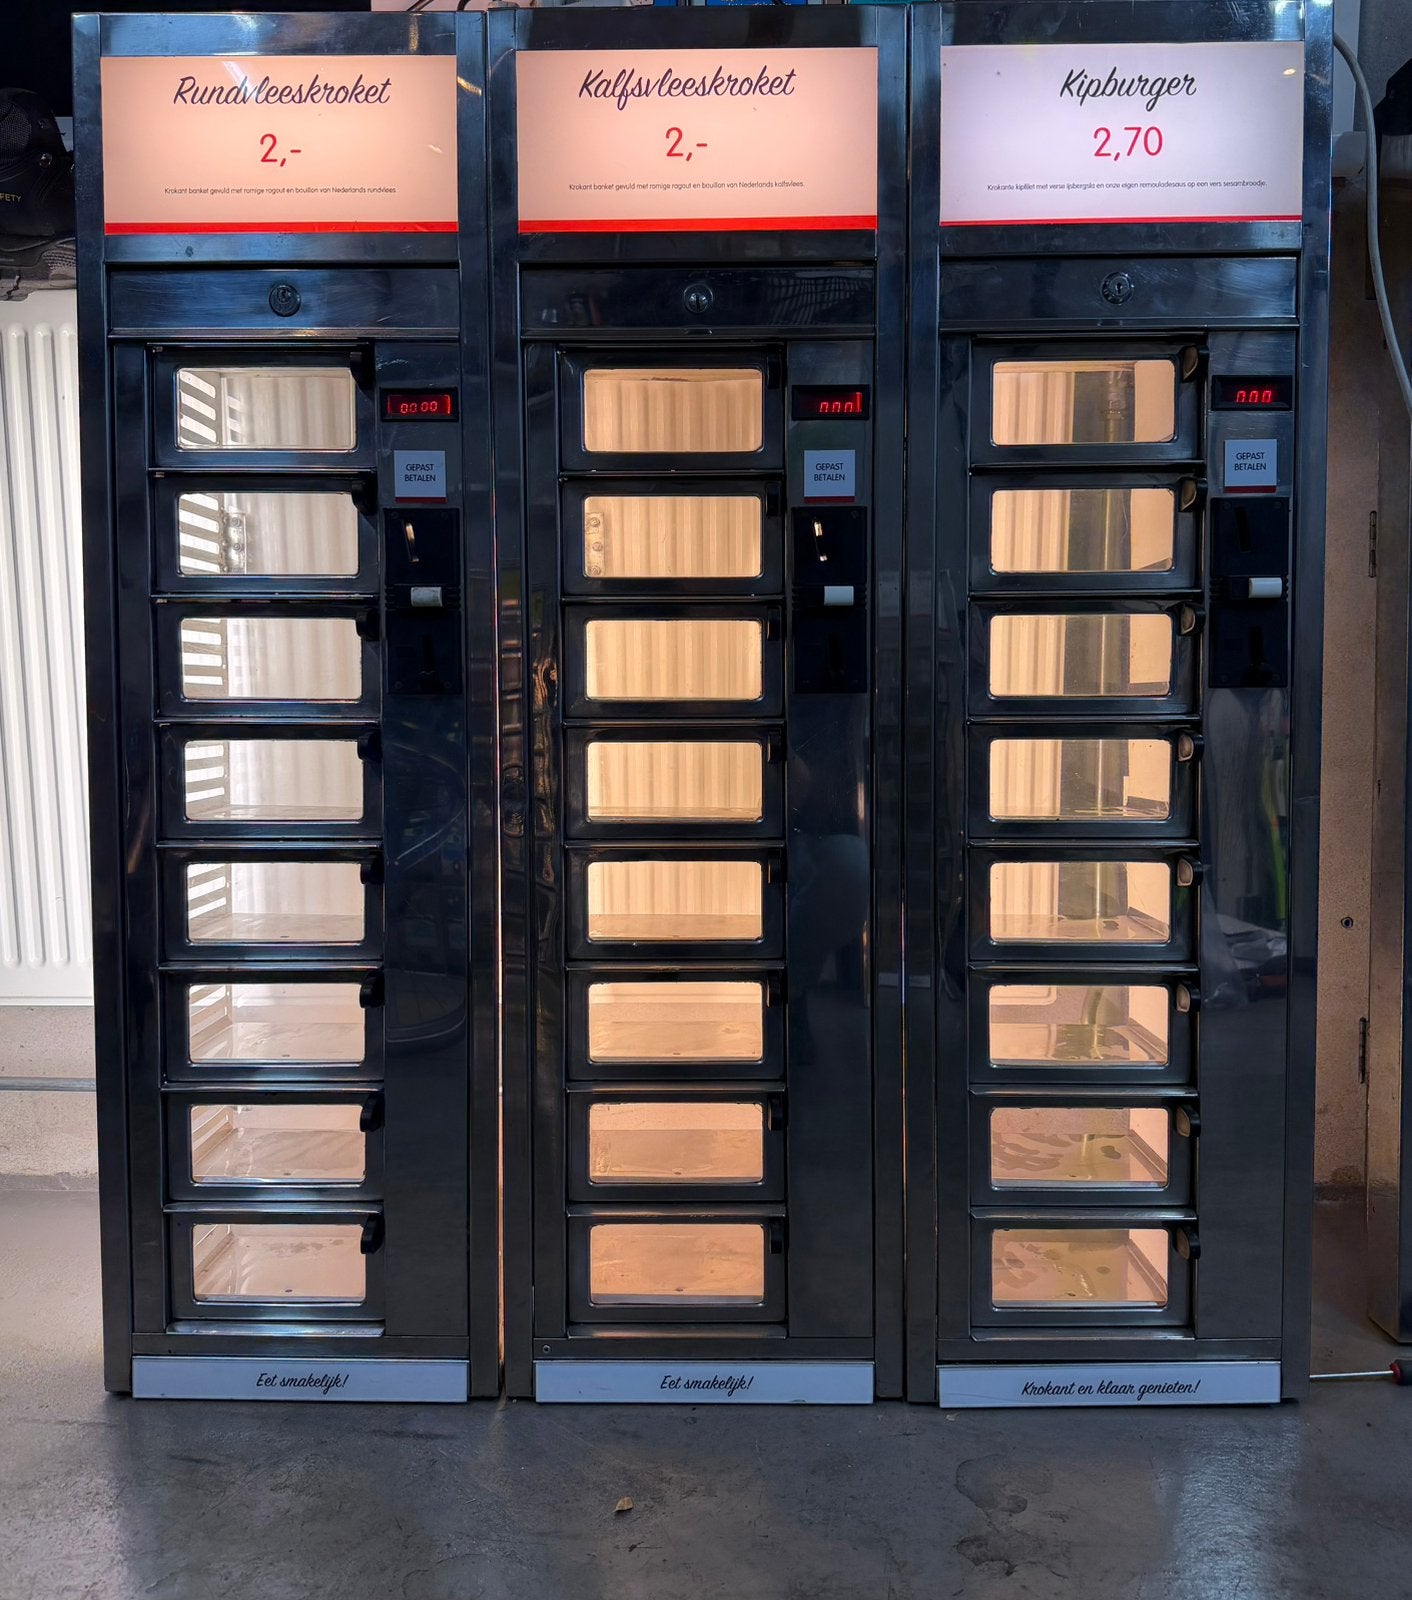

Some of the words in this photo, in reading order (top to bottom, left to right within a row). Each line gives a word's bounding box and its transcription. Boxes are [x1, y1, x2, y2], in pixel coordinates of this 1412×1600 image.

[173, 73, 392, 105] Rundvleeskroket
[579, 65, 797, 111] Kalfsvleeskroket
[1060, 66, 1197, 112] Kipburger
[259, 133, 301, 167] 2,-
[665, 126, 708, 162] 2,-
[1093, 126, 1163, 161] 2,70
[210, 187, 230, 195] gevuld
[243, 187, 264, 195] romige
[265, 187, 285, 195] ragout
[615, 183, 635, 191] gevuld
[1121, 182, 1138, 190] eigen
[1236, 452, 1265, 460] GEPAST
[815, 463, 844, 471] GEPAST
[1234, 463, 1266, 471] BETALEN
[404, 474, 436, 482] BETALEN
[256, 1373, 277, 1388] Eet
[280, 1372, 350, 1395] smakelijk!
[660, 1375, 681, 1390] Eet
[684, 1375, 754, 1397] smakelijk!
[1022, 1380, 1076, 1395] Krokant
[1078, 1386, 1094, 1394] en
[1097, 1381, 1135, 1394] klaar
[1138, 1380, 1201, 1401] genieten!
